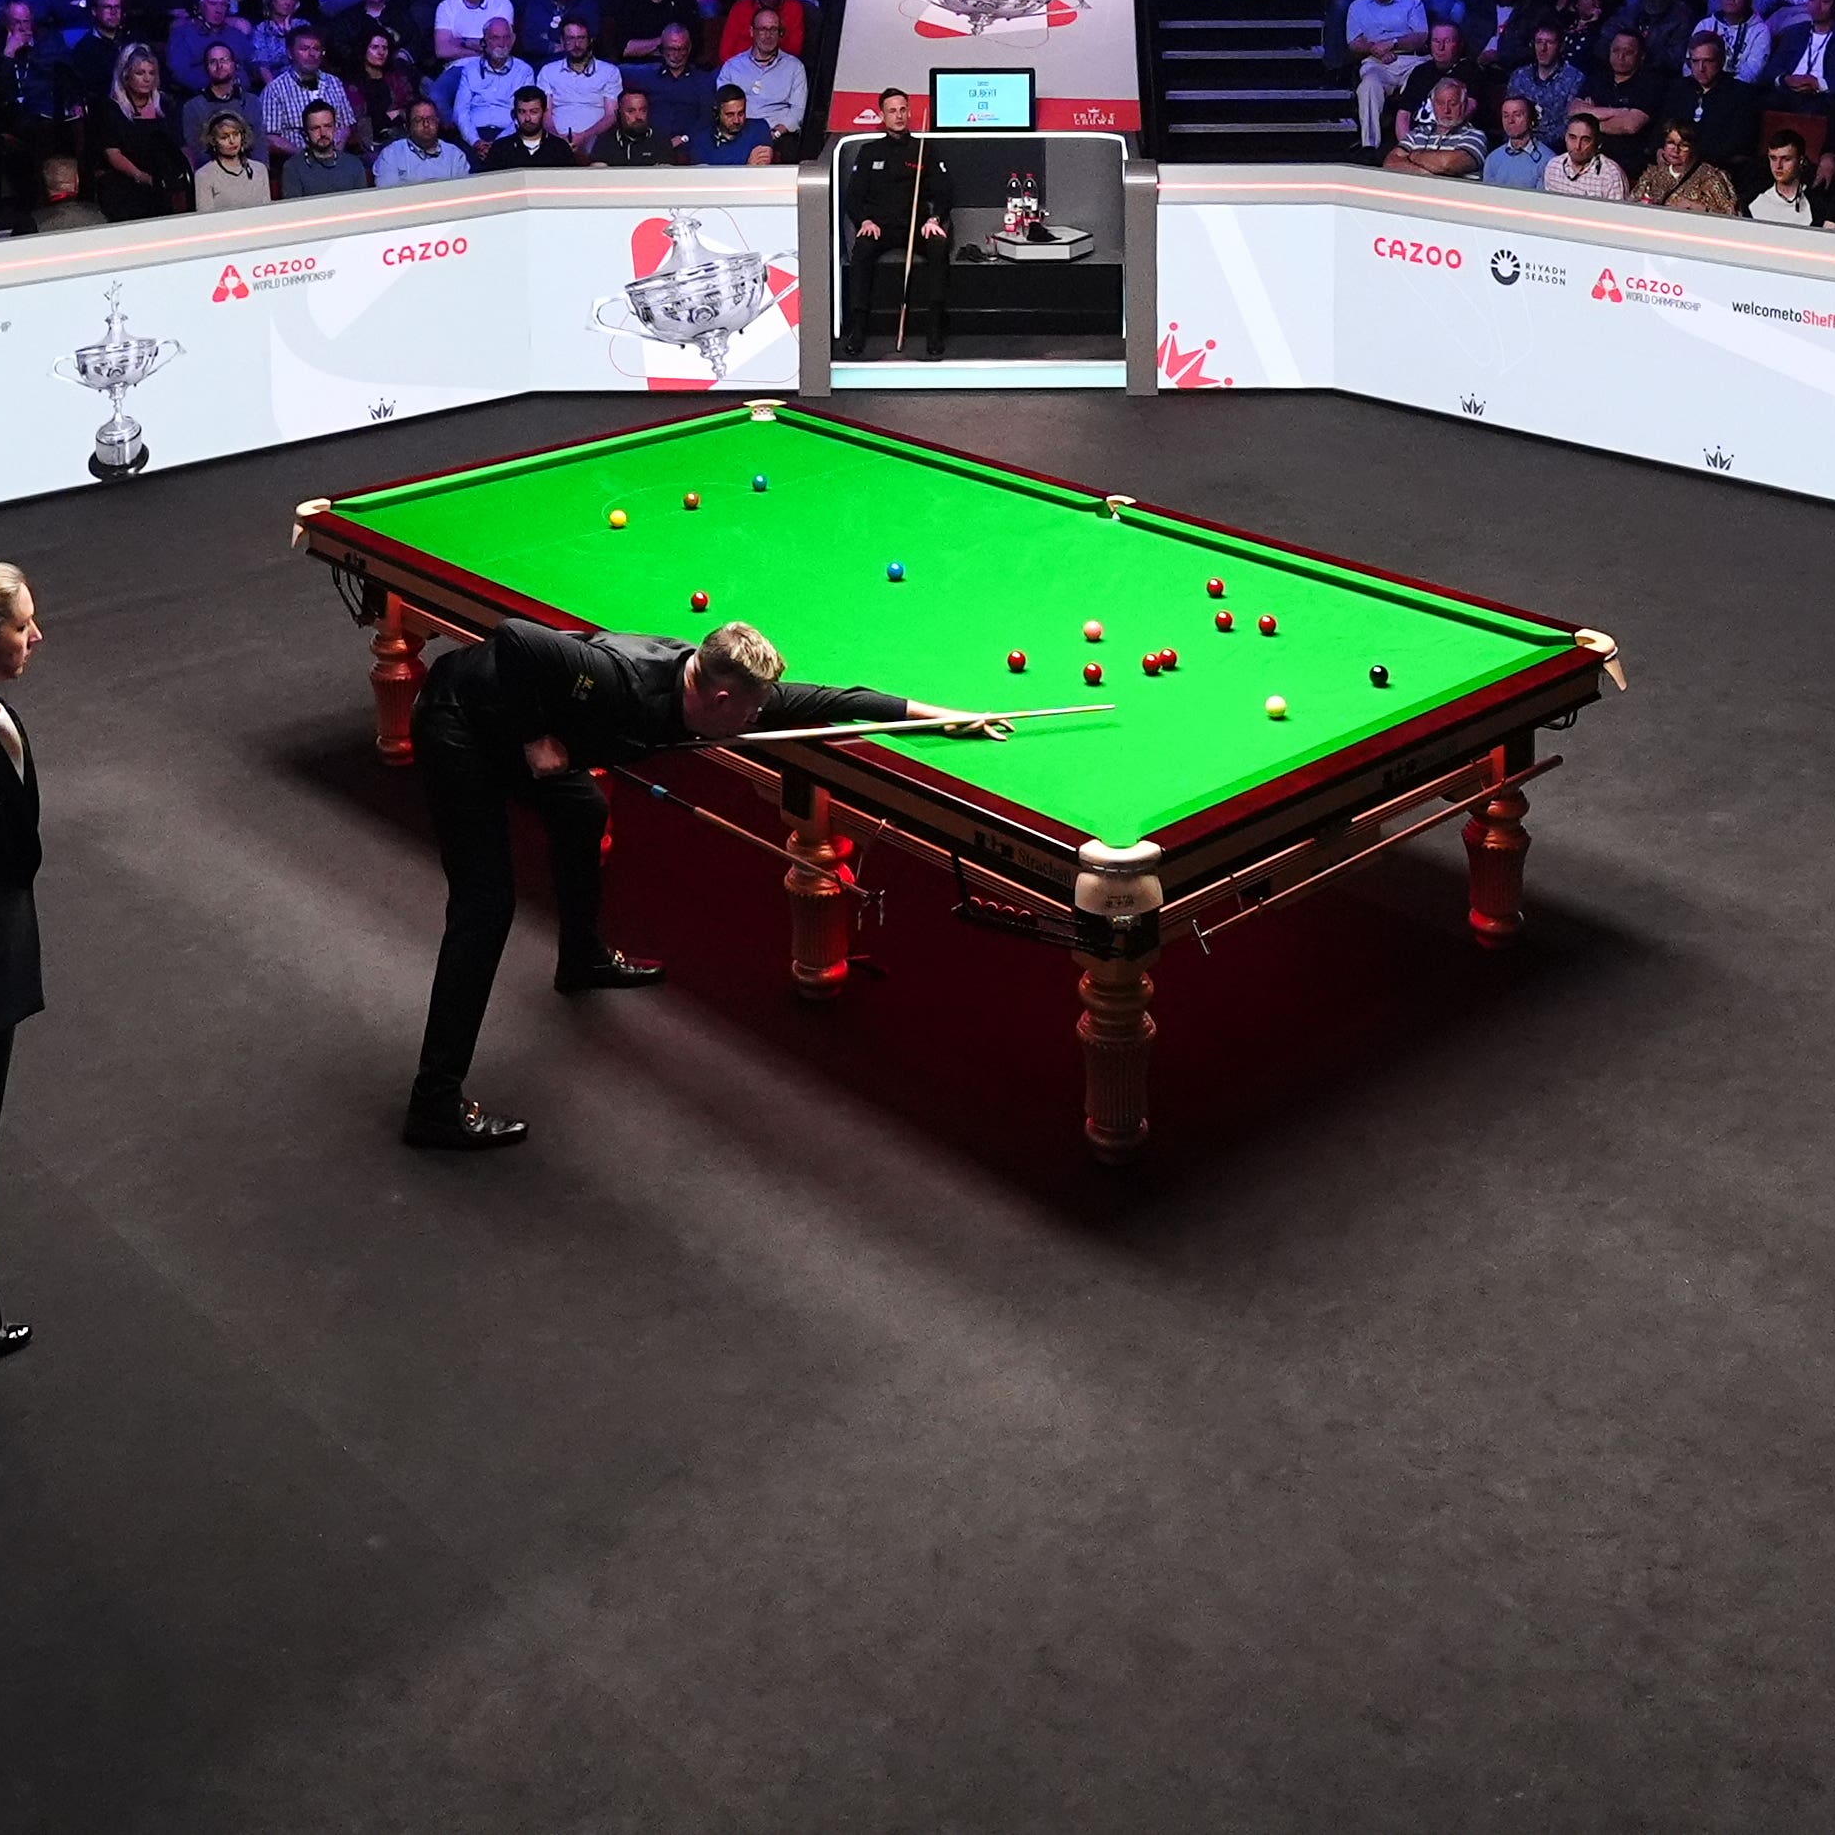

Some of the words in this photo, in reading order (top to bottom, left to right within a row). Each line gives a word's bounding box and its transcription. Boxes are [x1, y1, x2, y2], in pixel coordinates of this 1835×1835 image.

[382, 237, 468, 266] CAZOO
[1374, 237, 1462, 270] CAZOO
[252, 257, 316, 278] CAZOO
[1524, 262, 1567, 277] RIYADH
[252, 276, 281, 292] WORLD
[281, 269, 337, 288] CHAMPIONSHIP
[1524, 272, 1567, 286] SEASON
[1625, 276, 1684, 297] CAZOO
[1625, 291, 1650, 304] WORLD
[1650, 294, 1702, 312] CHAMPIONSHIP
